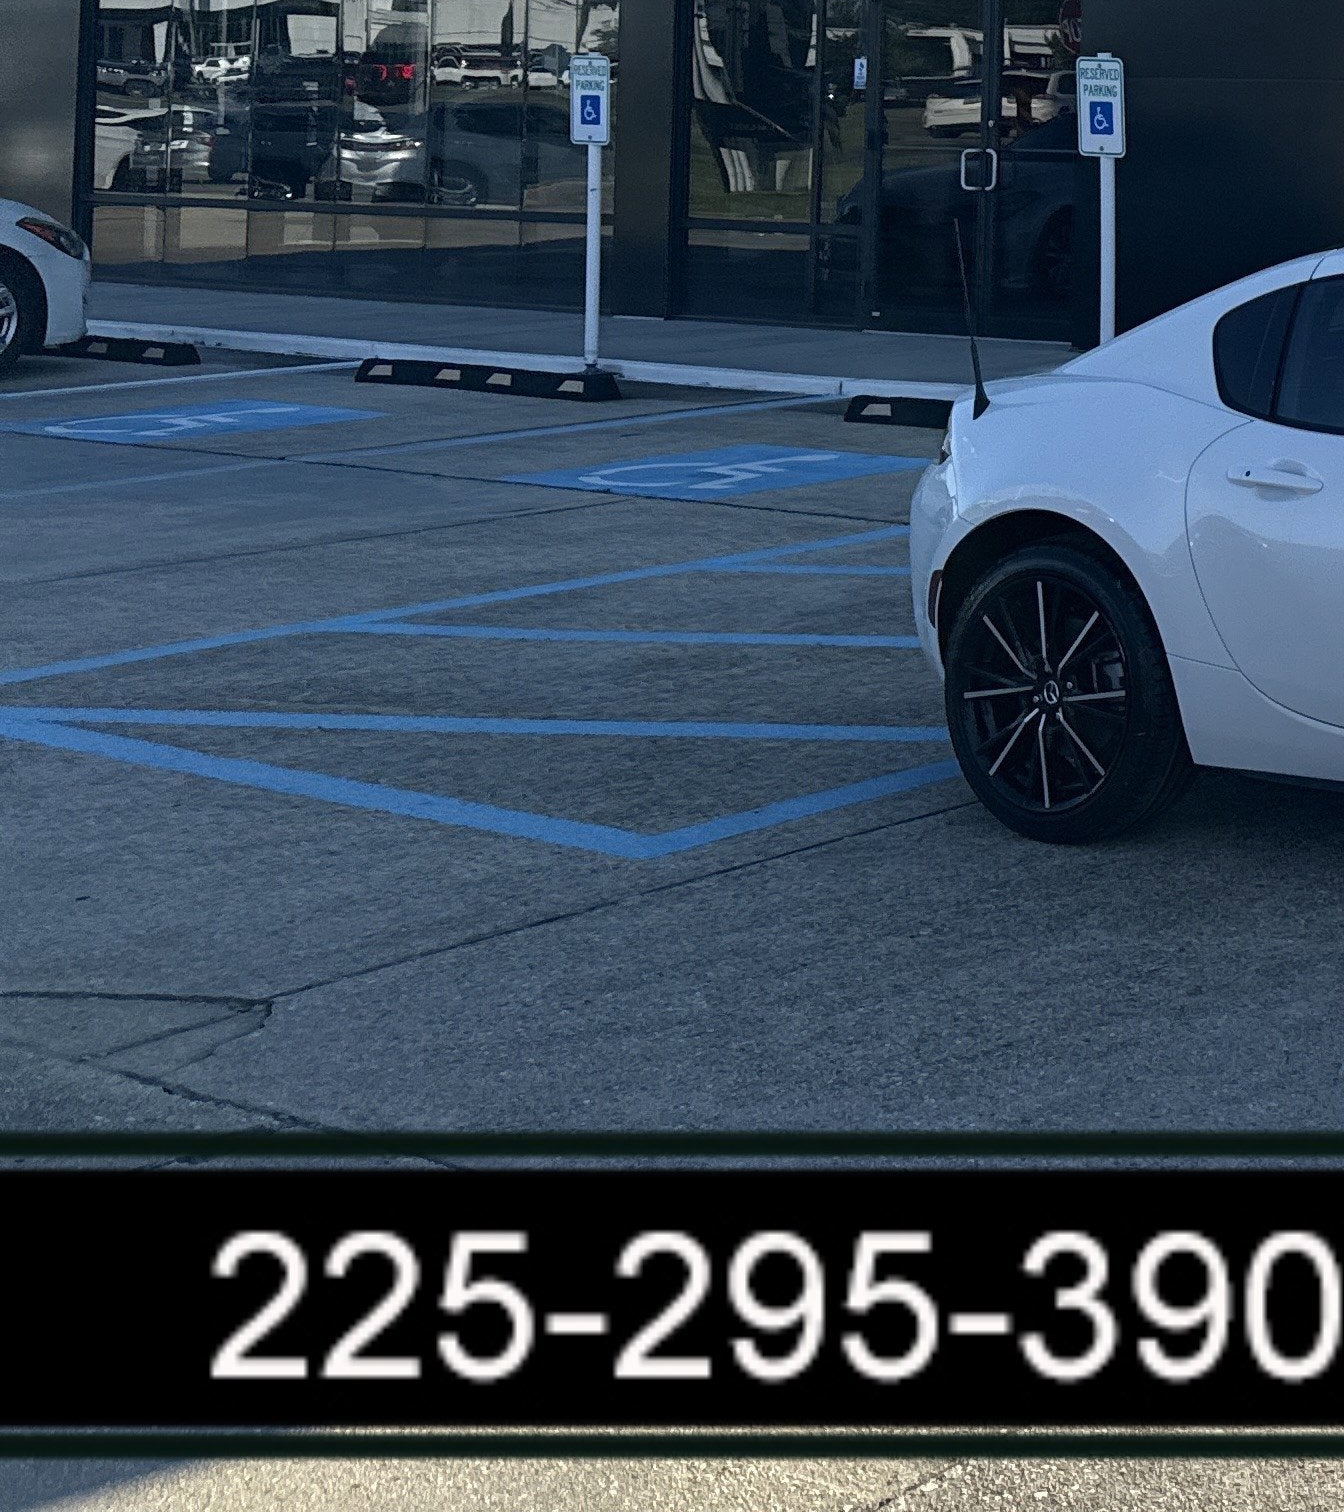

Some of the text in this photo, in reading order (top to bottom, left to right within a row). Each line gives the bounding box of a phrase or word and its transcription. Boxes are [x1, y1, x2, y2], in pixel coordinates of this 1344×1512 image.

[1080, 67, 1120, 80] RESERVED
[575, 79, 605, 91] PARKING
[1083, 84, 1118, 97] PARKING
